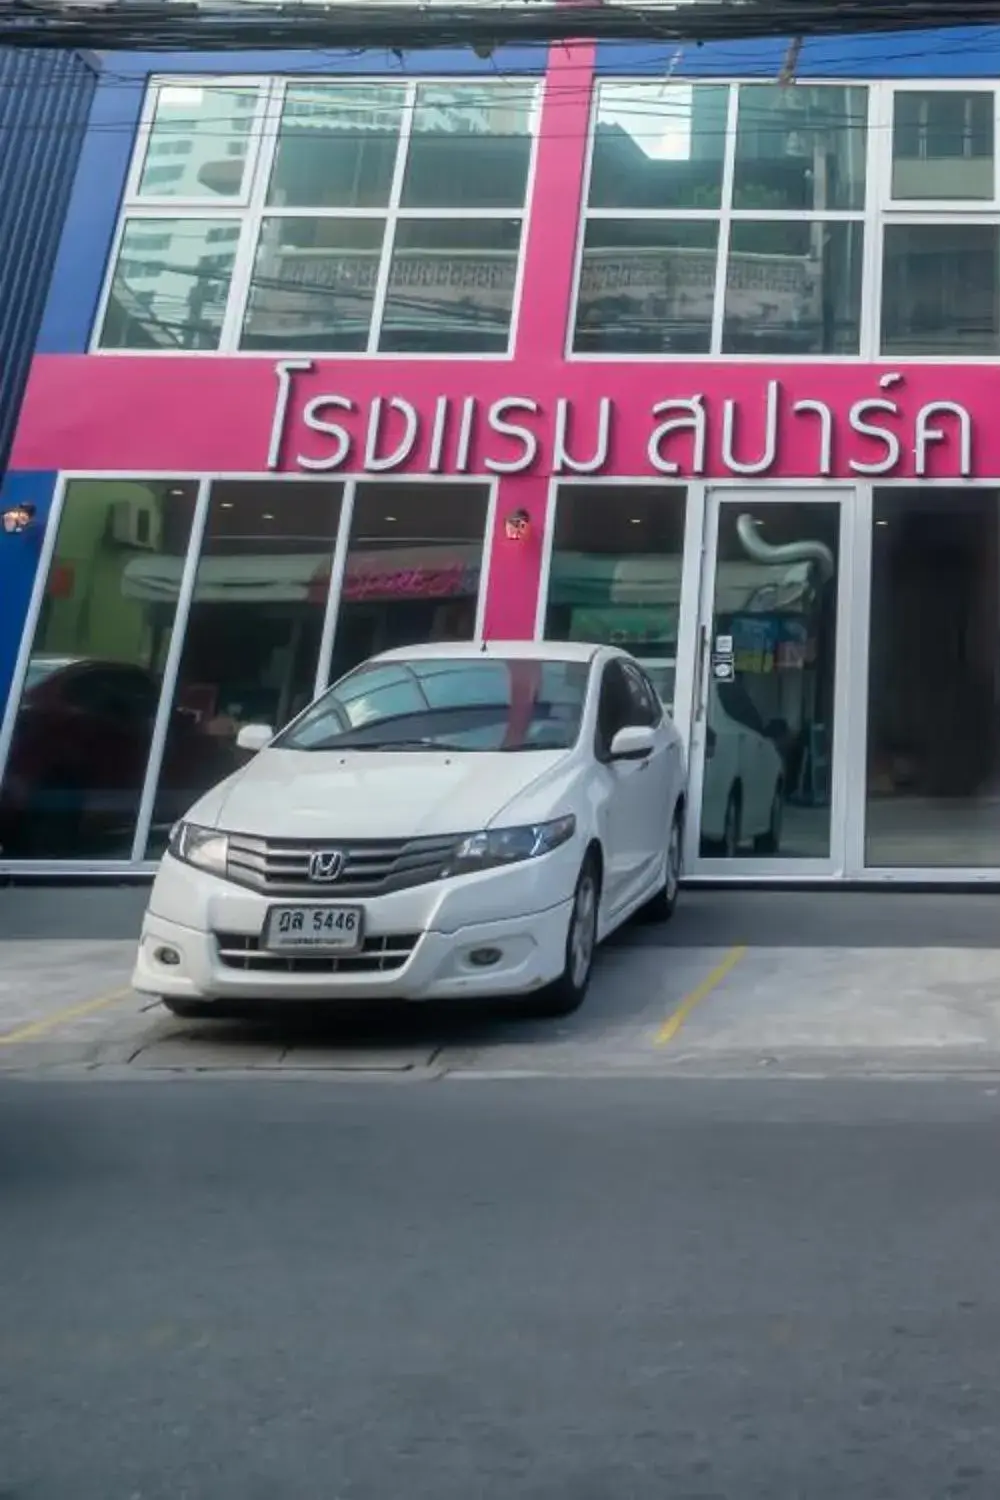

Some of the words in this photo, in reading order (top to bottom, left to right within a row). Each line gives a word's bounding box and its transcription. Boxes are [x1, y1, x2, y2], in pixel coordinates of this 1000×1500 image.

[266, 358, 613, 475] โรงแรม
[647, 371, 976, 477] สปาร์ค
[312, 910, 356, 932] 5446
